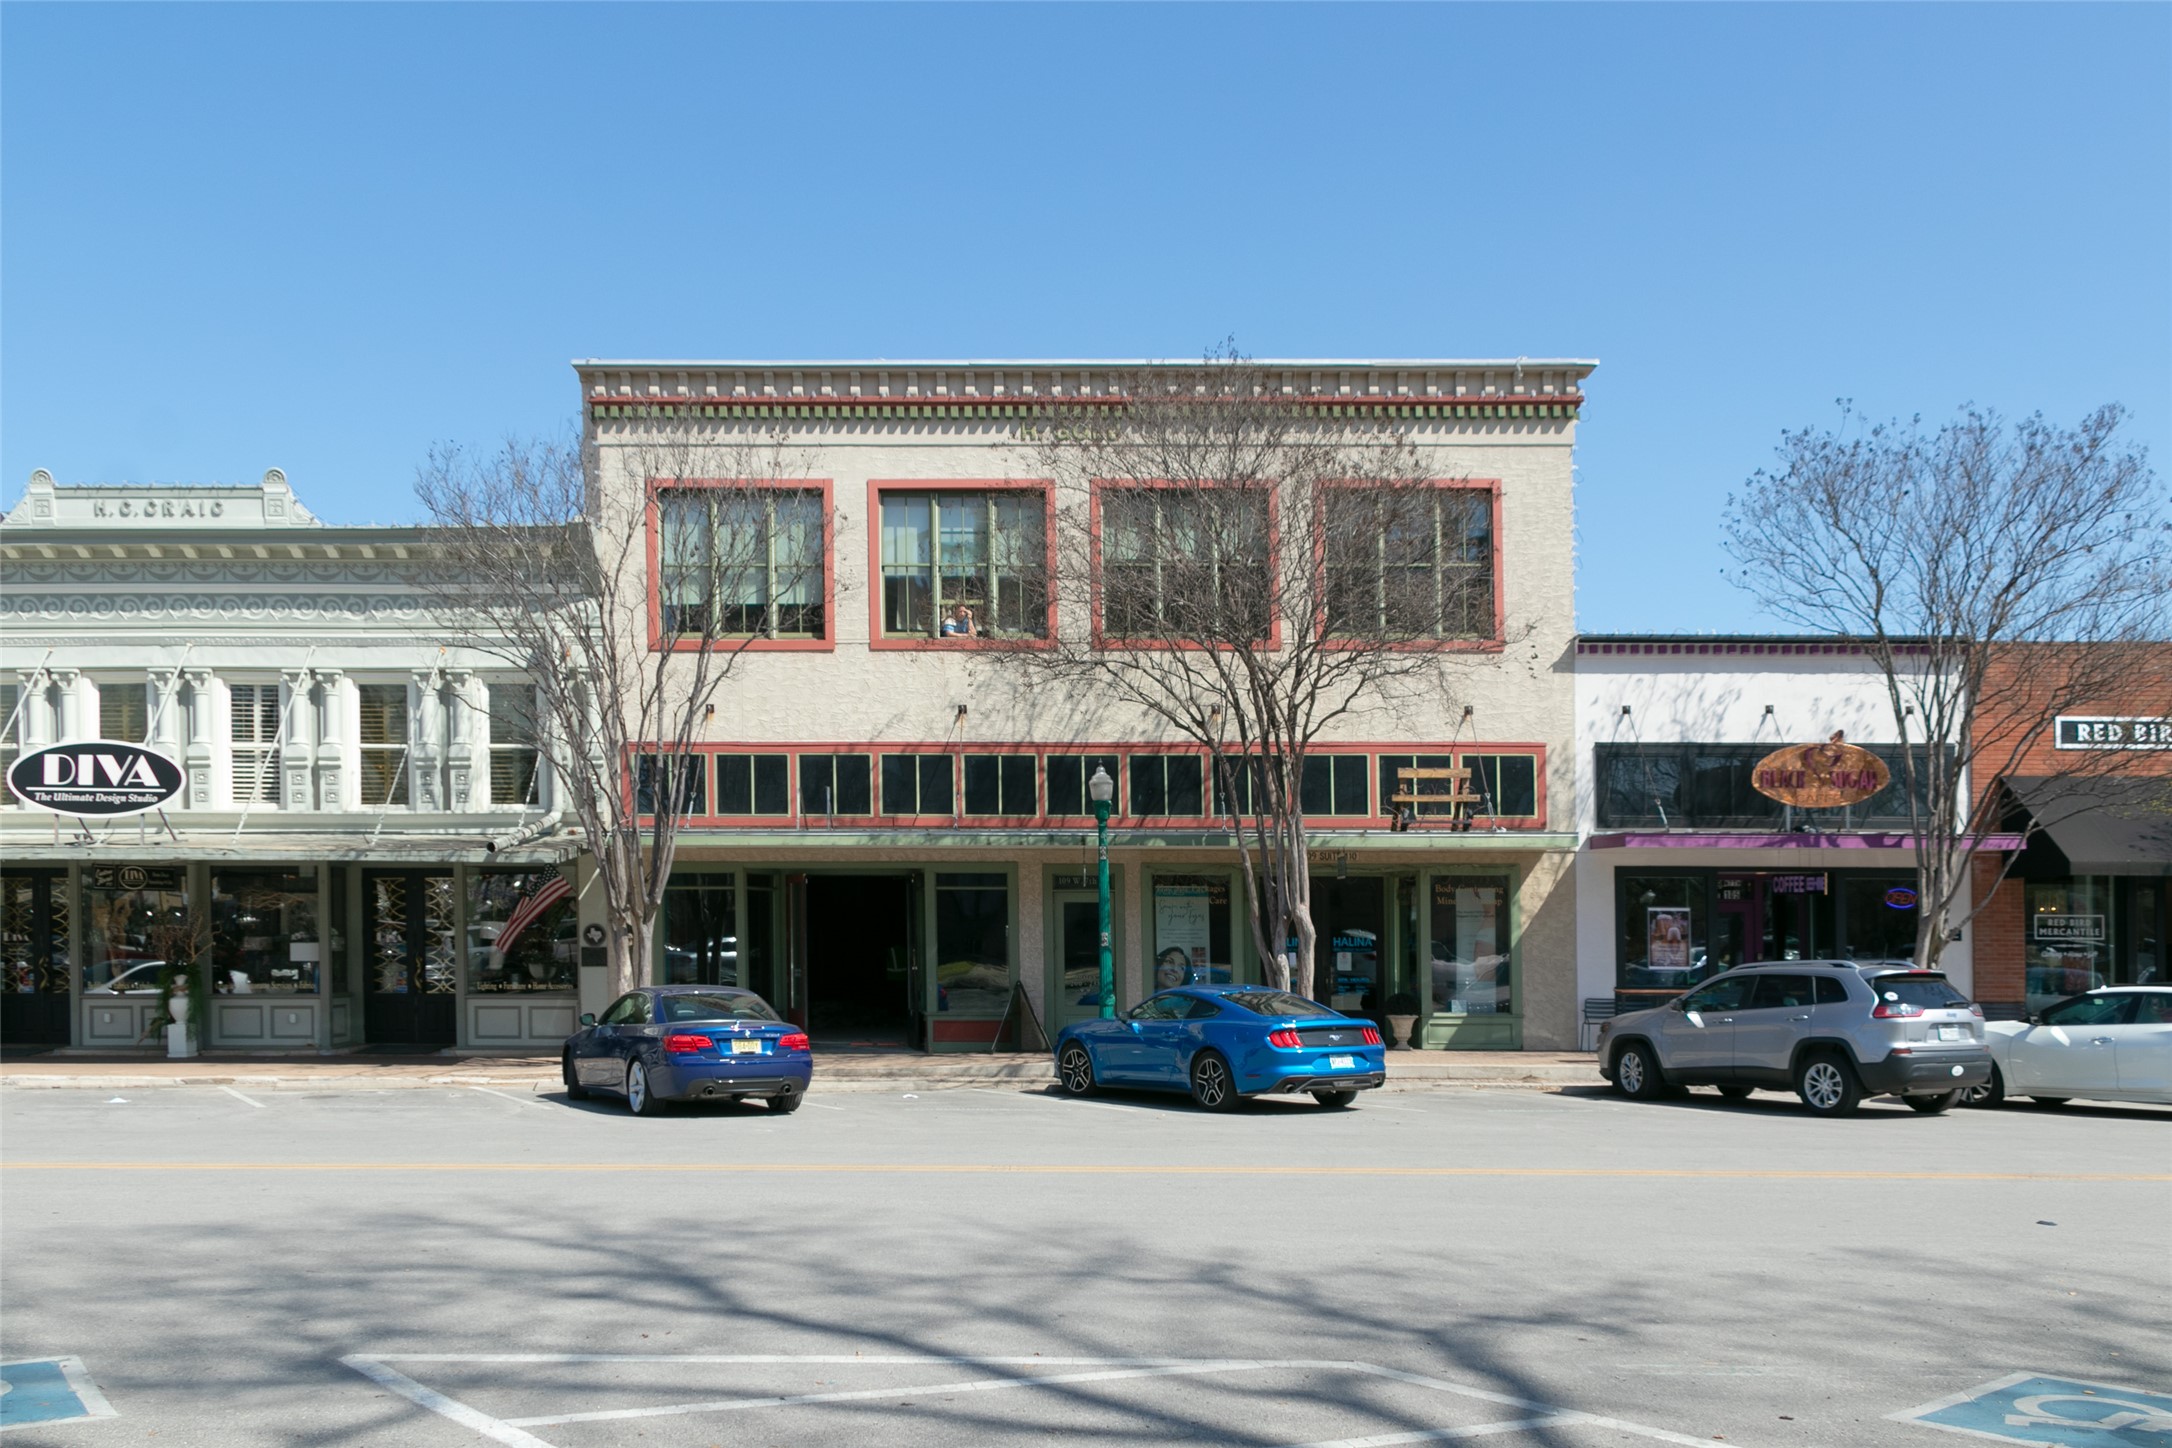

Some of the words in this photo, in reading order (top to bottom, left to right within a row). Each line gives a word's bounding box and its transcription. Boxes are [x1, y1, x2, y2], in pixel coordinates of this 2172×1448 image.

[2077, 723, 2122, 742] RED
[43, 753, 161, 787] DIVA
[1759, 768, 1806, 789] BLACK
[34, 792, 51, 802] The
[53, 792, 95, 803] Ultimate
[95, 793, 127, 805] Design
[128, 793, 158, 803] Studio
[1058, 876, 1071, 885] 109
[1072, 876, 1081, 885] W
[1772, 876, 1805, 893] COFFEE
[1435, 883, 1455, 893] Body
[1209, 896, 1228, 905] Care
[1884, 891, 1919, 905] OPEN
[2047, 918, 2066, 926] RED
[2069, 918, 2092, 926] BIRD
[2038, 927, 2100, 936] MERCANTILE
[1333, 936, 1373, 947] HALINA
